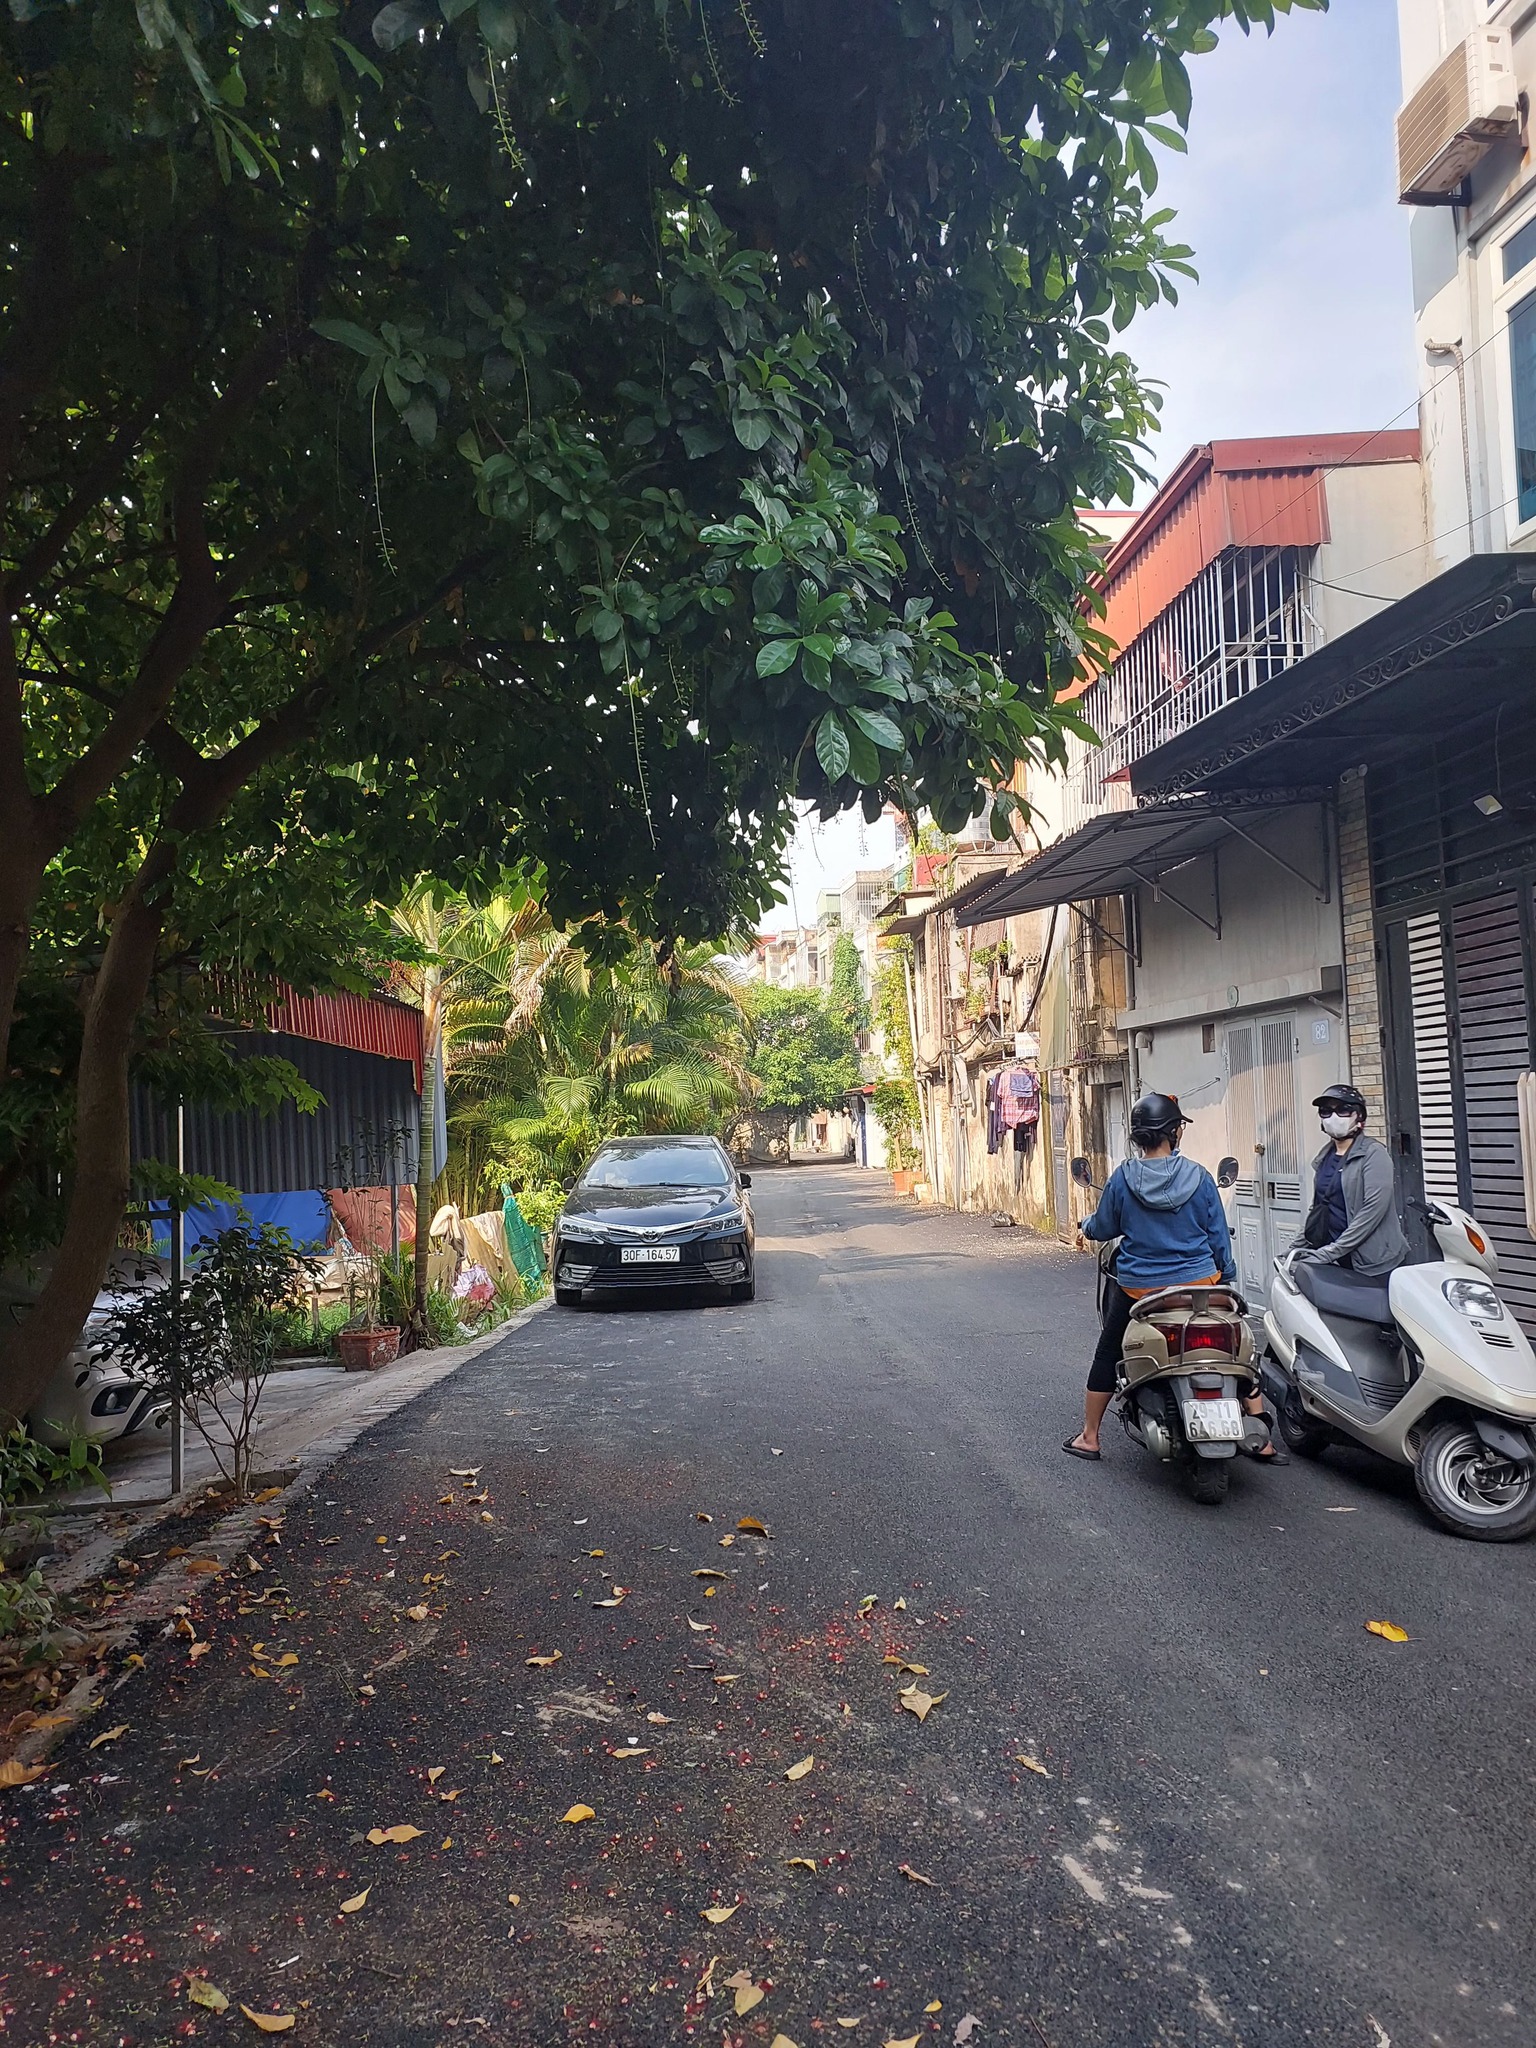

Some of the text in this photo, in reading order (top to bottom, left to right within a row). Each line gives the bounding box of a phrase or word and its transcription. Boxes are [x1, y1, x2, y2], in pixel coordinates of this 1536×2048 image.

[1315, 1023, 1326, 1040] 82
[623, 1249, 678, 1261] 30F-164.57
[1193, 1401, 1232, 1419] 29-T1
